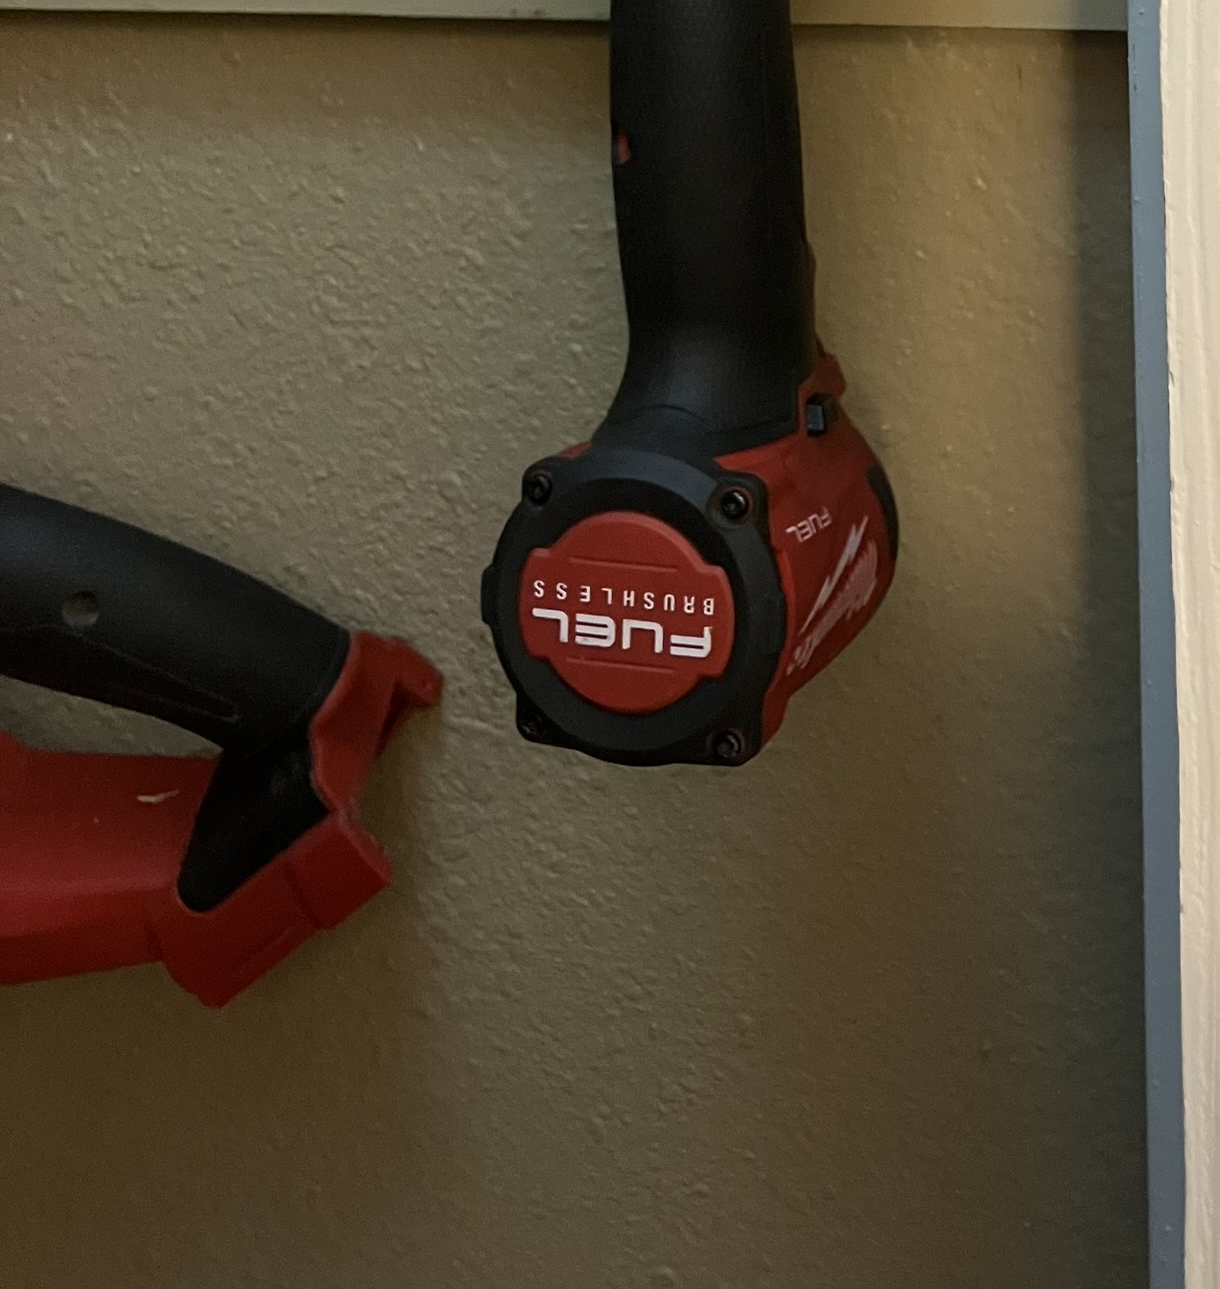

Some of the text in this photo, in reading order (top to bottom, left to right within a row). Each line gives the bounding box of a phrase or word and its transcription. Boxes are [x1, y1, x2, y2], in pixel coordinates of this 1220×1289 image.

[785, 506, 833, 543] FUEL
[533, 580, 715, 616] BRUSHLESS
[532, 607, 713, 659] FUEL
